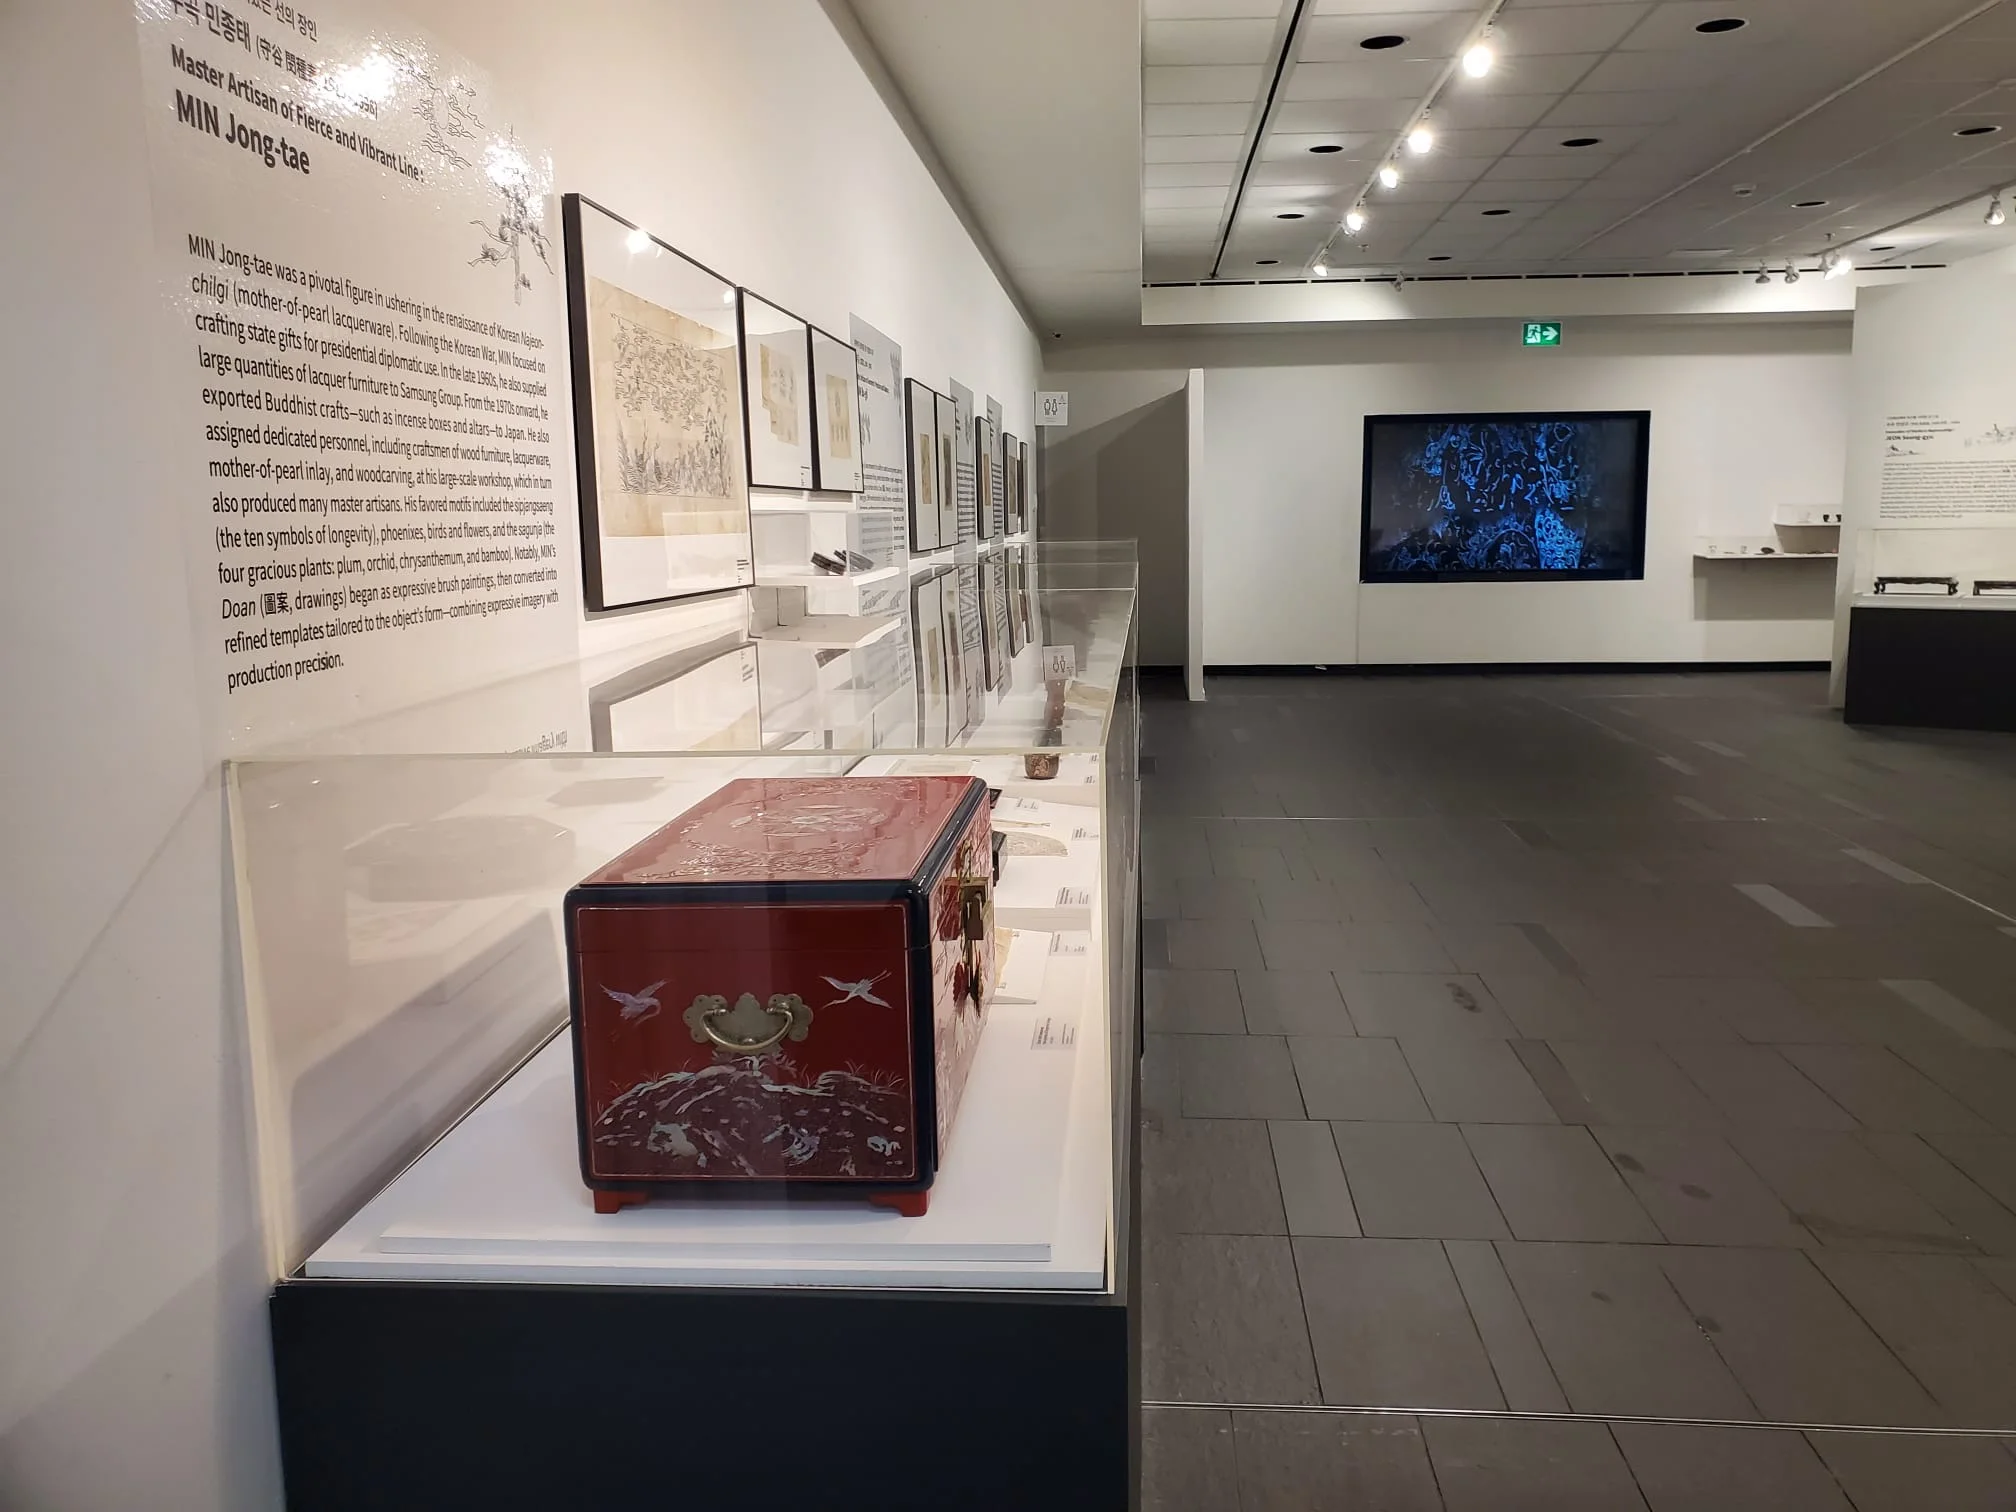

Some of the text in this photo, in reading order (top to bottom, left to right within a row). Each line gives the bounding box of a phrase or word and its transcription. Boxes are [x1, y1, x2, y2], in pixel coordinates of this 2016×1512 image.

[205, 1, 251, 53] 민종태
[275, 0, 295, 30] 선의
[297, 12, 317, 43] 장인
[171, 43, 224, 89] Master
[227, 71, 278, 115] Artisan
[280, 100, 294, 122] of
[295, 104, 333, 141] Fierce
[335, 128, 357, 152] and
[357, 134, 397, 171] Vibrant
[175, 88, 310, 174] MIN Jong-tae
[188, 233, 215, 261] MIN
[218, 243, 273, 277] Jong-tae
[274, 263, 298, 284] was
[299, 271, 306, 286] a
[308, 269, 344, 296] pivotal
[345, 278, 373, 305] figure
[374, 287, 384, 307] in
[384, 293, 422, 322] ushering
[422, 301, 431, 320] in
[431, 305, 445, 323] the
[445, 313, 488, 335] renaissance
[488, 321, 496, 337] of
[496, 324, 520, 343] Korean
[191, 272, 546, 373] chilgi (mother-of-pearl lacquerware). Following the Korean War, MIN focused on
[195, 312, 547, 398] crafting state gifts for presidential diplomatic use. In the late 1960s, he also supplied
[198, 344, 548, 421] large quantities of lacquer furniture to Samsung Group. From the 1970s onward, he
[202, 388, 262, 411] exported
[264, 391, 318, 417] Buddhist
[382, 411, 393, 425] as
[394, 408, 427, 429] incense
[428, 412, 452, 432] boxes
[452, 417, 468, 433] and
[504, 424, 527, 443] Japan.
[527, 427, 537, 441] He
[537, 427, 550, 442] also
[205, 420, 551, 469] assigned dedicated personnel, including craftsmen of wood furniture, lacquerware,
[208, 455, 552, 491] mother-of-pearl inlay, and woodcarving, at his large-scale workshop, which in turn
[212, 491, 238, 513] also
[241, 491, 297, 518] produced
[298, 498, 328, 517] many
[330, 495, 364, 512] master
[365, 494, 403, 512] artisans.
[403, 495, 418, 512] His
[418, 494, 448, 512] favored
[448, 495, 472, 512] motifs
[471, 496, 502, 512] included
[502, 496, 514, 512] the
[243, 528, 264, 547] ten
[266, 525, 314, 551] symbols
[315, 524, 326, 544] of
[327, 523, 379, 548] longevity),
[380, 523, 426, 546] phoenixes,
[426, 522, 447, 539] birds
[448, 522, 463, 538] and
[463, 521, 492, 540] flowers,
[492, 521, 506, 537] and
[506, 521, 518, 536] the
[217, 562, 245, 584] four
[247, 559, 297, 587] gracious
[298, 557, 335, 582] plants:
[336, 555, 365, 579] plum,
[366, 552, 398, 572] orchid,
[399, 550, 466, 573] chrysanthemum,
[466, 547, 480, 564] and
[480, 546, 514, 563] bamboo).
[514, 544, 540, 562] Notably,
[221, 598, 256, 619] Doan
[294, 586, 347, 611] drawings)
[348, 585, 378, 607] began
[380, 586, 391, 600] as
[392, 578, 436, 601] expressive
[436, 575, 460, 593] brush
[460, 572, 496, 594] paintings,
[496, 570, 513, 586] then
[513, 567, 545, 584] converted
[545, 567, 558, 581] into
[224, 628, 268, 654] refined
[269, 623, 325, 648] templates
[325, 615, 363, 638] tailored
[364, 615, 374, 632] to
[375, 612, 391, 630] the
[487, 594, 521, 615] expressive
[521, 591, 545, 610] imagery
[545, 588, 559, 604] with
[227, 651, 344, 695] production precision.
